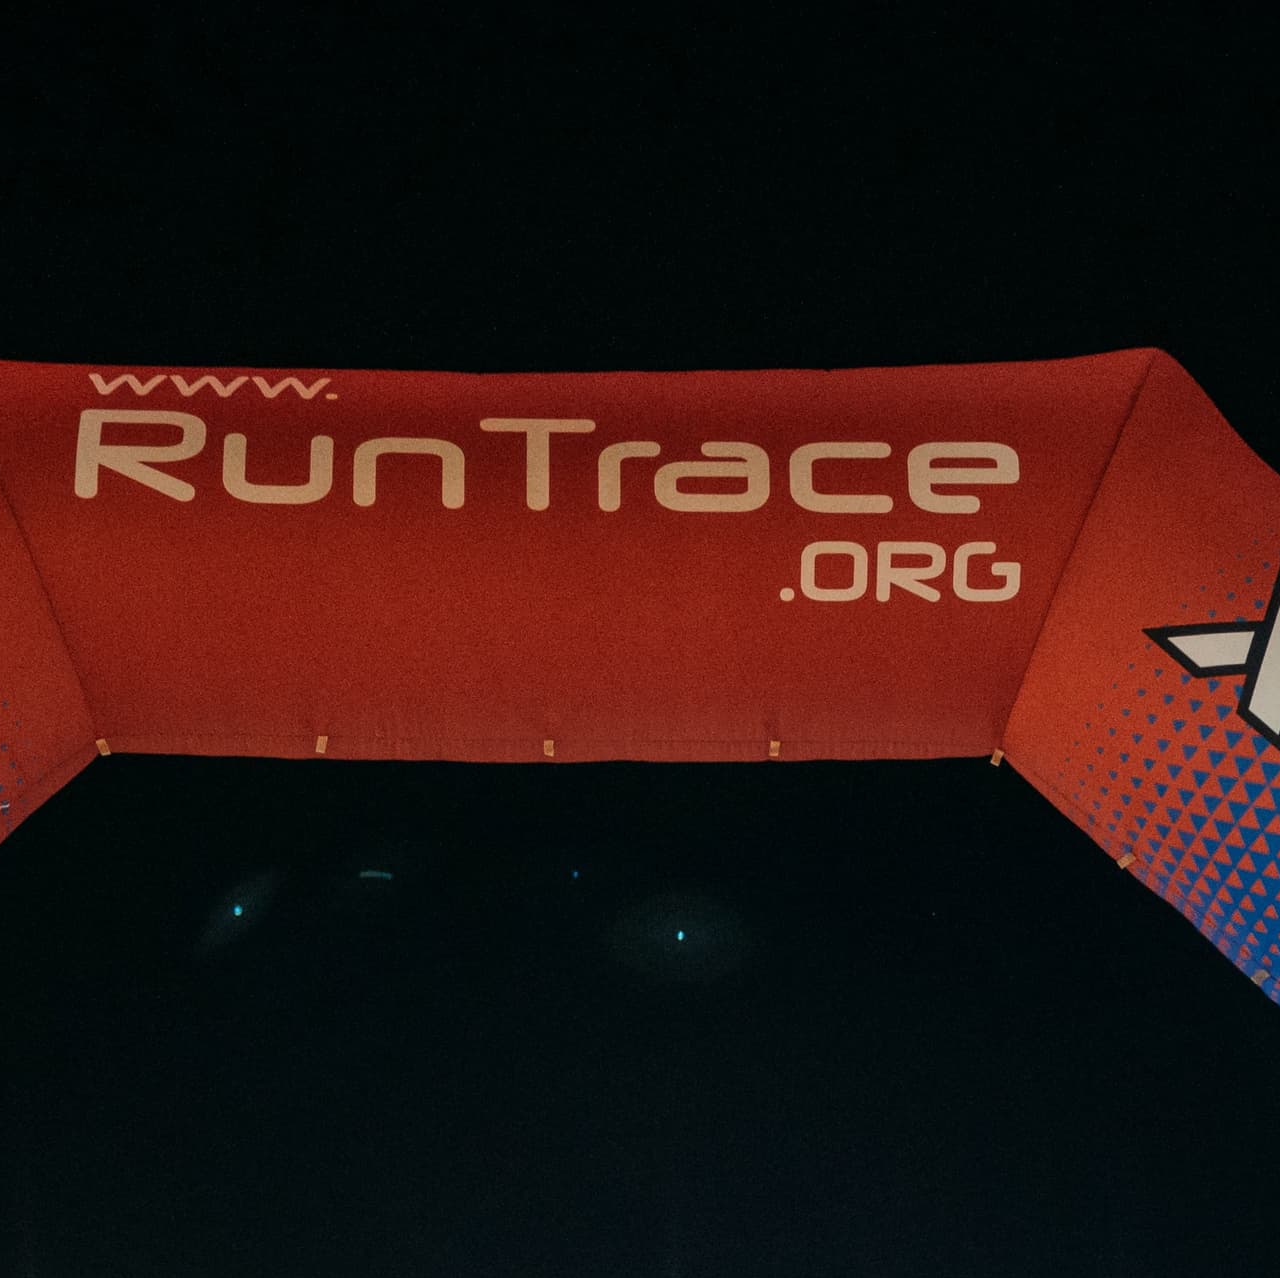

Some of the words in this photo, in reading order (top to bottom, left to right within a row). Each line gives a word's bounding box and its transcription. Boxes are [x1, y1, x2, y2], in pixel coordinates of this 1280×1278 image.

[87, 371, 340, 402] www.
[72, 406, 1022, 515] RunTrace
[777, 539, 1022, 604] .ORG
